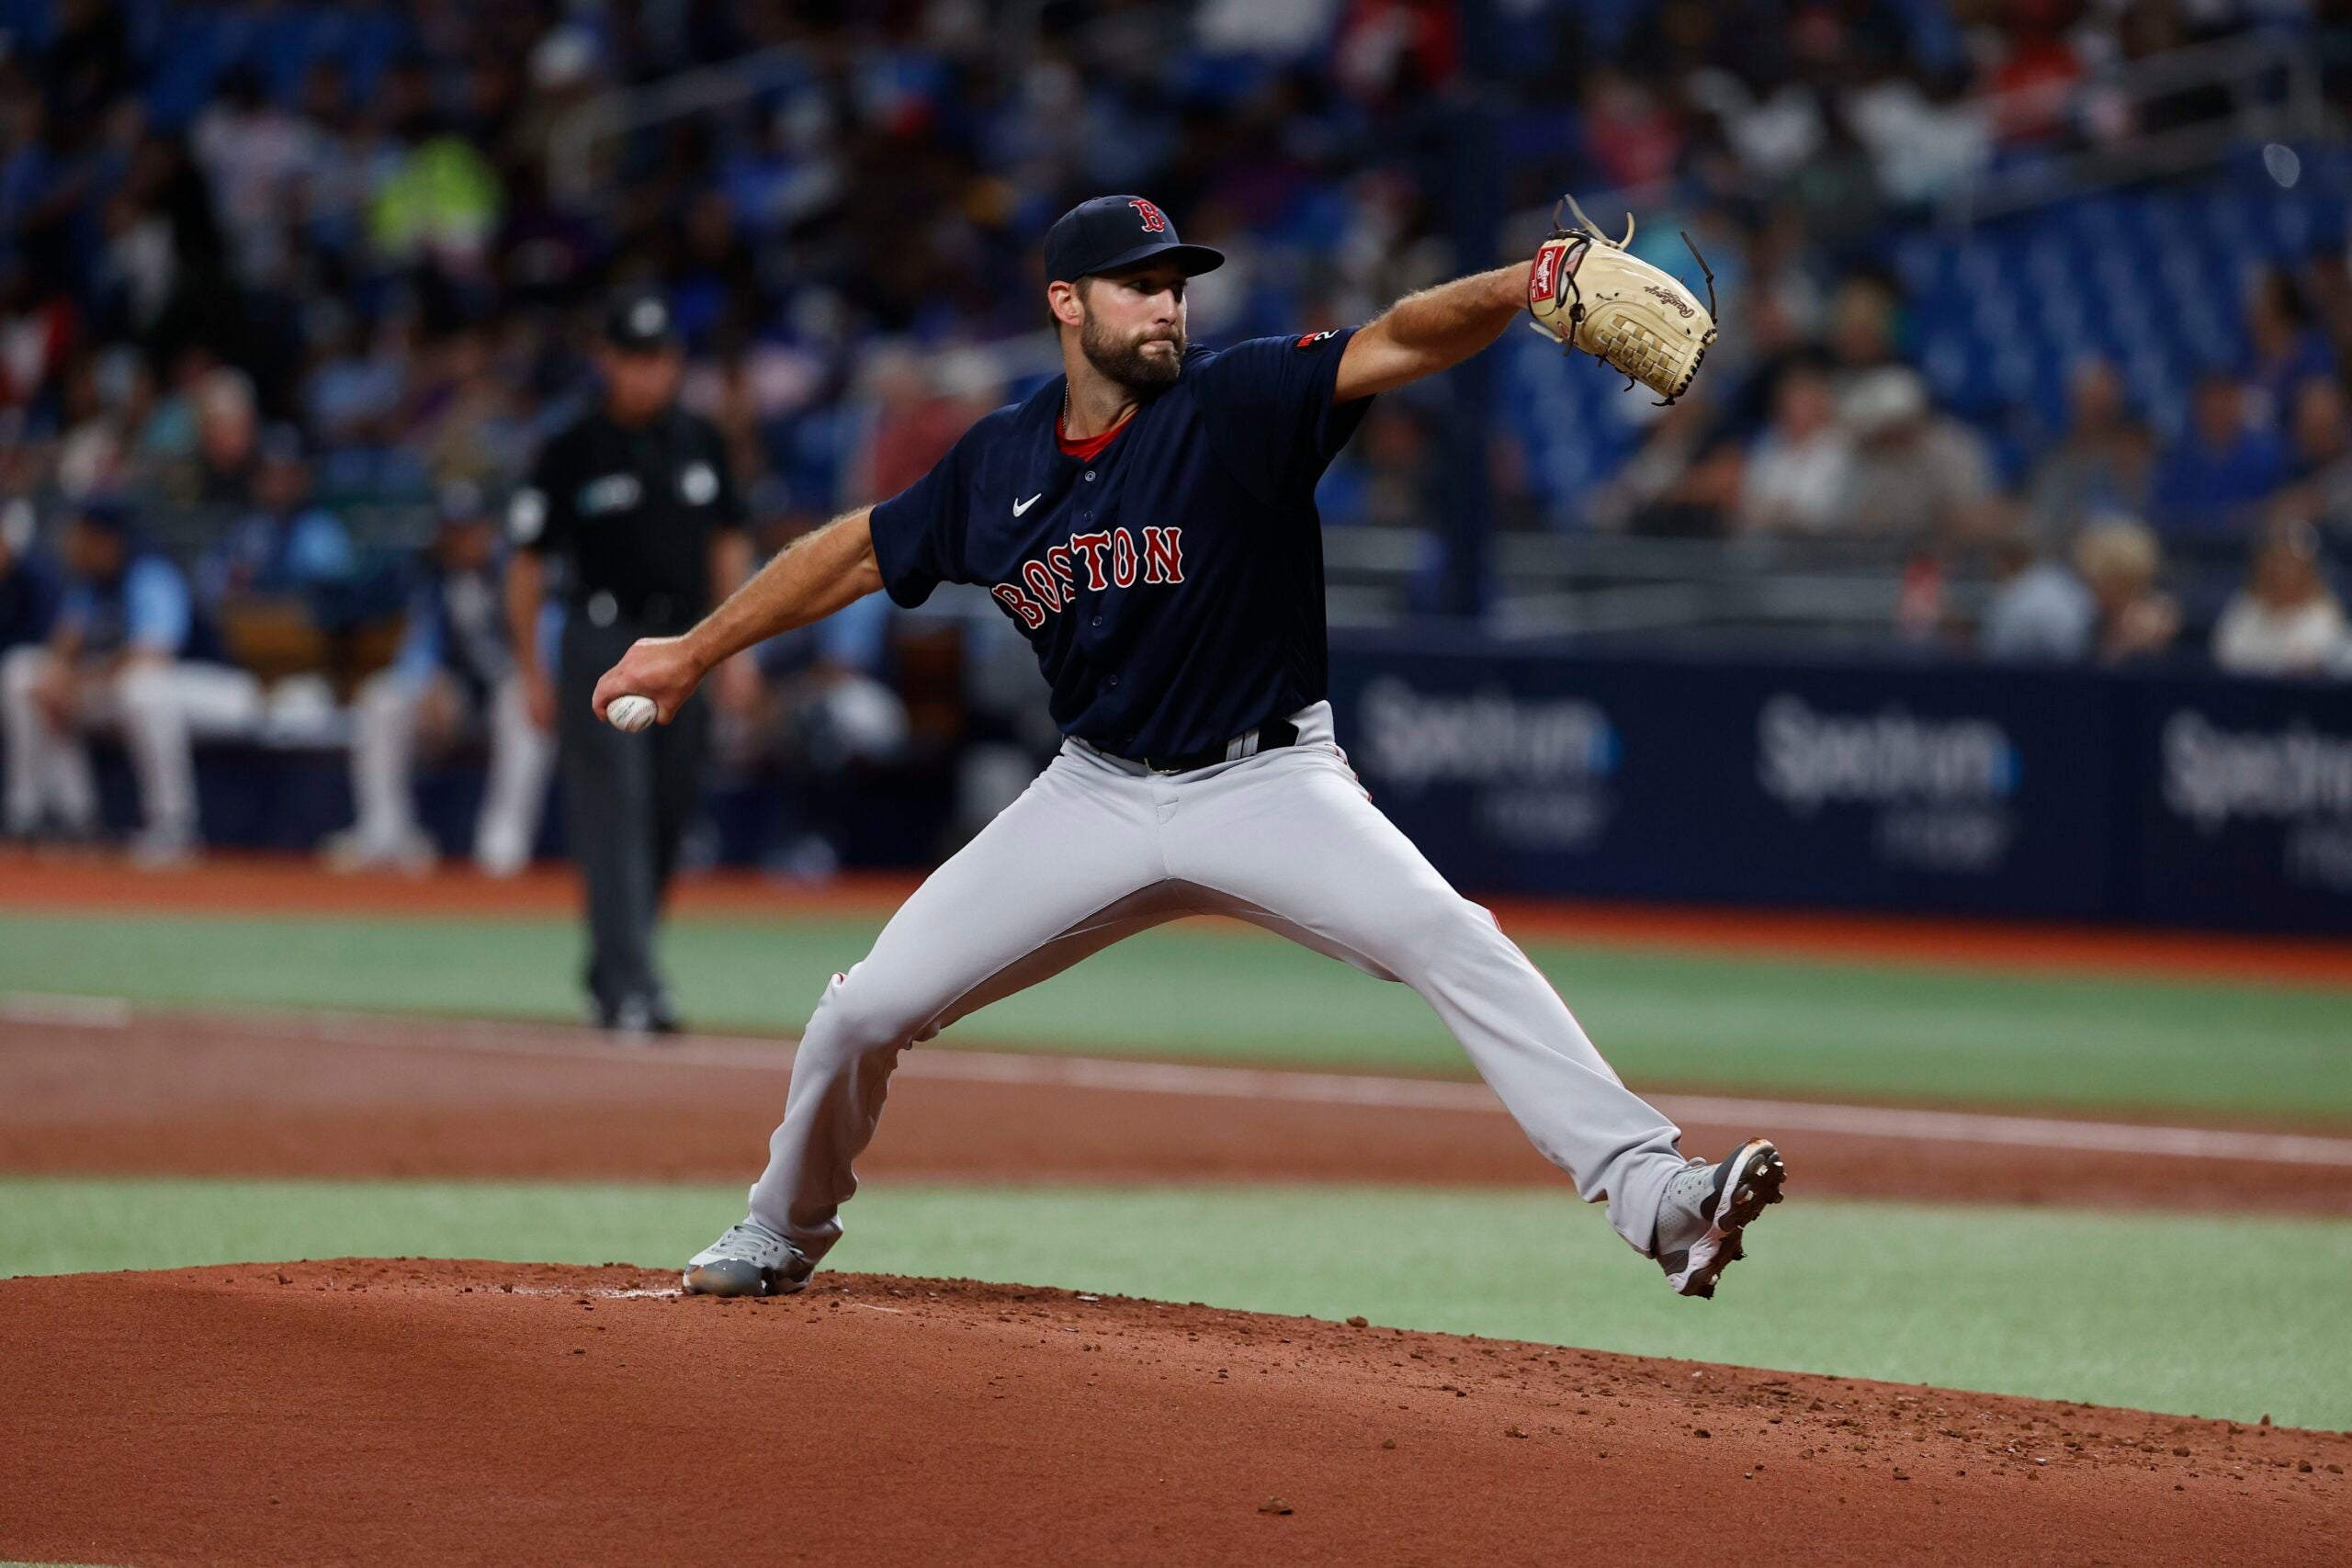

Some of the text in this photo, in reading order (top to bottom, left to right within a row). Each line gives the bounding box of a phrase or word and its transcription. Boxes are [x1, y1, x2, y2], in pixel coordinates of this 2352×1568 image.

[1128, 199, 1165, 232] B
[1643, 285, 1696, 319] Rawlings
[991, 525, 1185, 630] BOSTON
